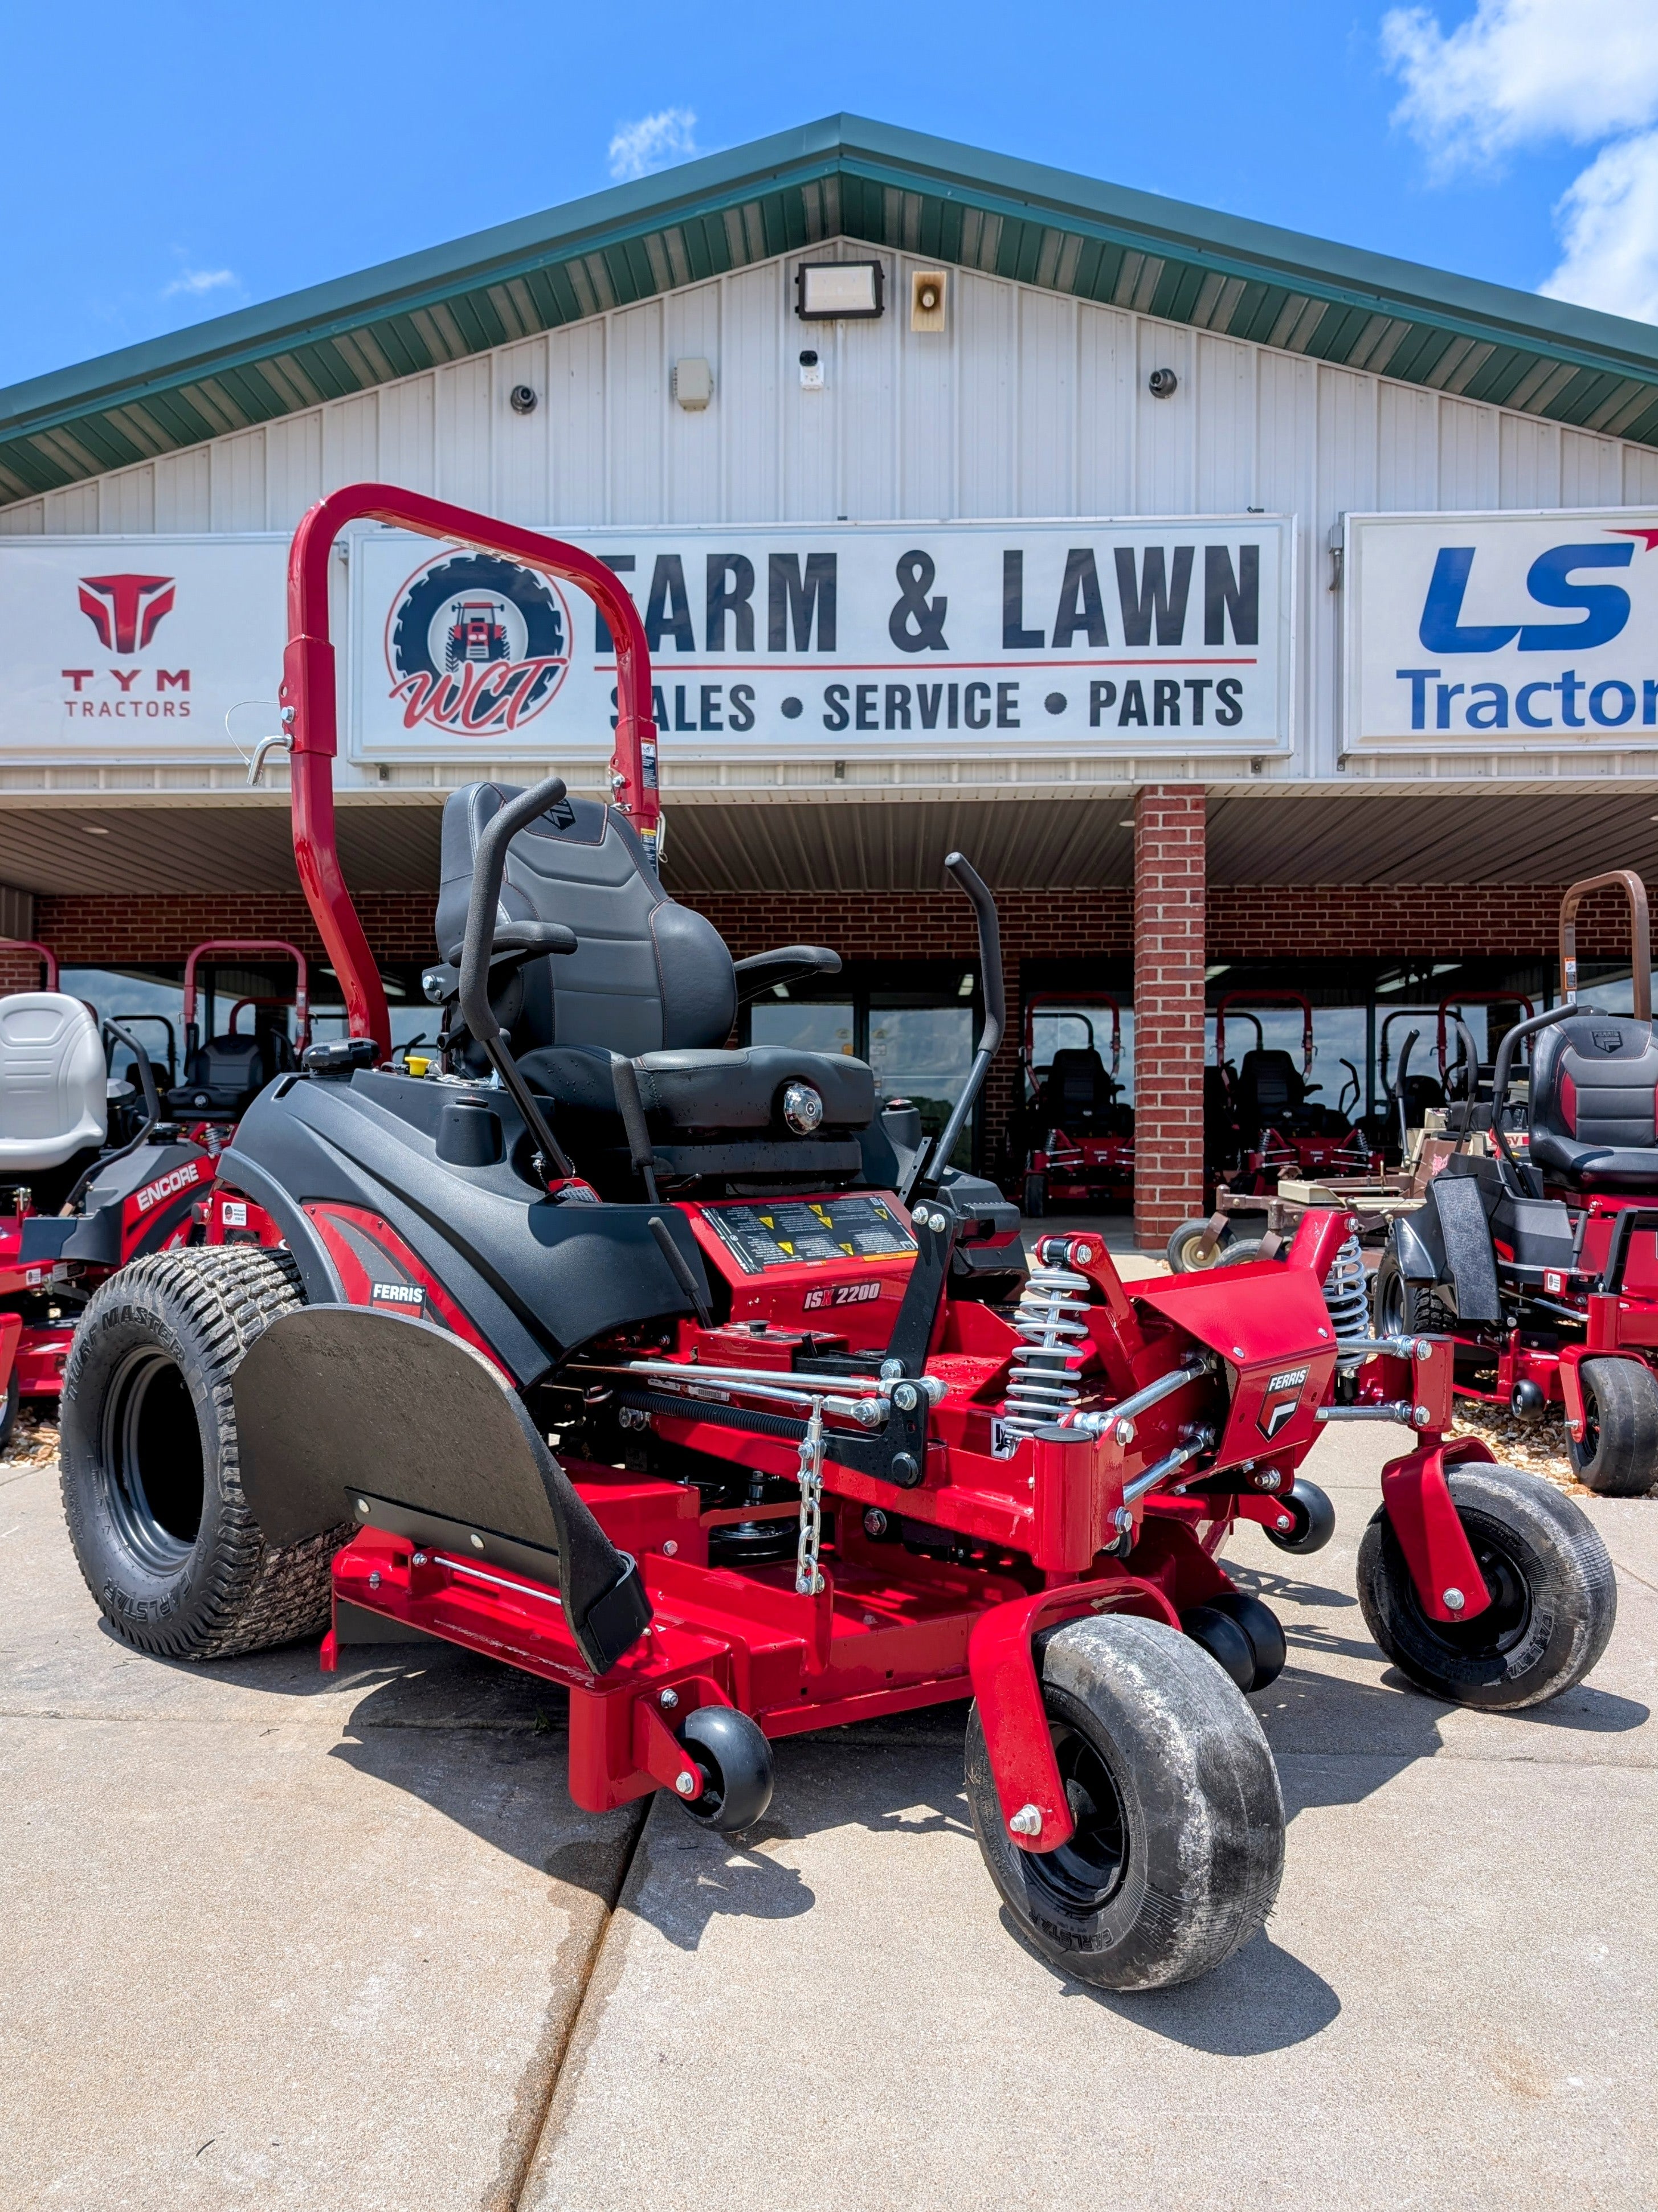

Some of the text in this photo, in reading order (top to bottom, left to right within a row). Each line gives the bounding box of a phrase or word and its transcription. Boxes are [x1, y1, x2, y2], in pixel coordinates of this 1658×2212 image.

[888, 549, 950, 653] &
[1002, 545, 1260, 649] LAWN
[1419, 542, 1635, 654] LS
[62, 669, 190, 692] TYM
[389, 657, 569, 730] WCT
[823, 681, 1021, 731] SERVICE
[1089, 678, 1243, 727] PARTS
[64, 701, 191, 717] TRACTORS
[137, 1163, 199, 1212] ENCORE
[373, 1283, 423, 1303] FERRIS
[804, 1283, 880, 1309] ISX 2200
[67, 1303, 186, 1401] TURF MASTER
[1268, 1369, 1306, 1392] FERRIS
[103, 1571, 193, 1622] CARLSTAR
[1028, 1907, 1114, 1951] CARLSTAR
